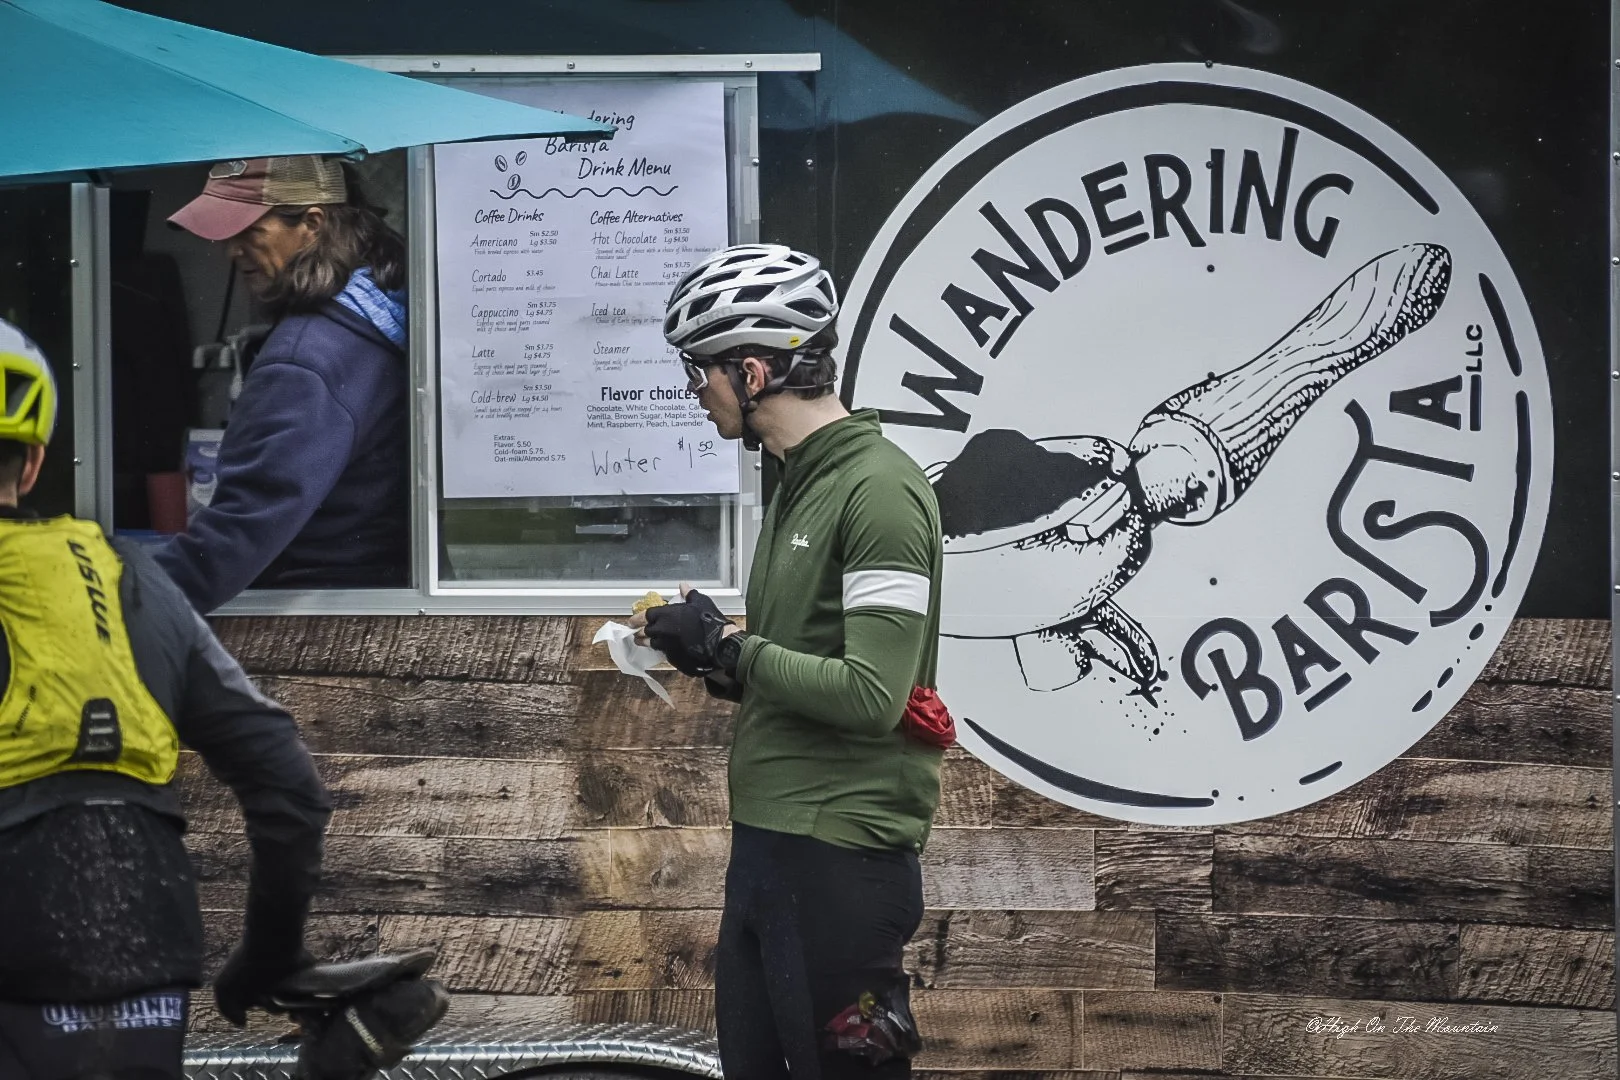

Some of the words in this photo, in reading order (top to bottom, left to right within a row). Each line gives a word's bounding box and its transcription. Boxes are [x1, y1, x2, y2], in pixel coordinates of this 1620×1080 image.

[545, 137, 609, 155] Barista
[578, 157, 625, 179] Drink
[628, 157, 671, 177] Menu
[475, 209, 505, 224] Coffee
[508, 208, 544, 223] Drinks
[590, 210, 620, 225] Coffee
[622, 210, 683, 223] Alternatives
[591, 231, 610, 245] Hot
[615, 231, 657, 244] Chocolate
[664, 227, 674, 235] Sm
[470, 234, 518, 247] Americano
[529, 239, 538, 247] Lg
[664, 236, 673, 244] Lg
[590, 265, 611, 279] Chai
[615, 266, 639, 279] Latte
[663, 261, 674, 269] Sm
[472, 268, 506, 282] Cortado
[526, 269, 544, 277] $3.45
[662, 271, 671, 279] Lg
[884, 127, 1354, 433] WANDERING
[527, 301, 538, 309] Sm
[591, 303, 609, 316] Iced
[613, 306, 626, 316] tea
[471, 304, 519, 322] Cappuccino
[472, 345, 495, 358] Latte
[593, 341, 630, 355] Steamer
[1466, 324, 1483, 372] LLC
[471, 389, 517, 403] Cold-brew
[521, 395, 530, 404] Lg
[601, 386, 644, 401] Flavor
[649, 386, 698, 400] choices
[614, 412, 639, 420] Brown
[640, 412, 663, 420] Sugar,
[665, 412, 687, 420] Maple
[606, 420, 645, 429] Raspberry,
[646, 420, 670, 428] Peach,
[671, 419, 704, 428] Lavender
[592, 447, 662, 476] Water
[1181, 375, 1489, 741] BARISTA
